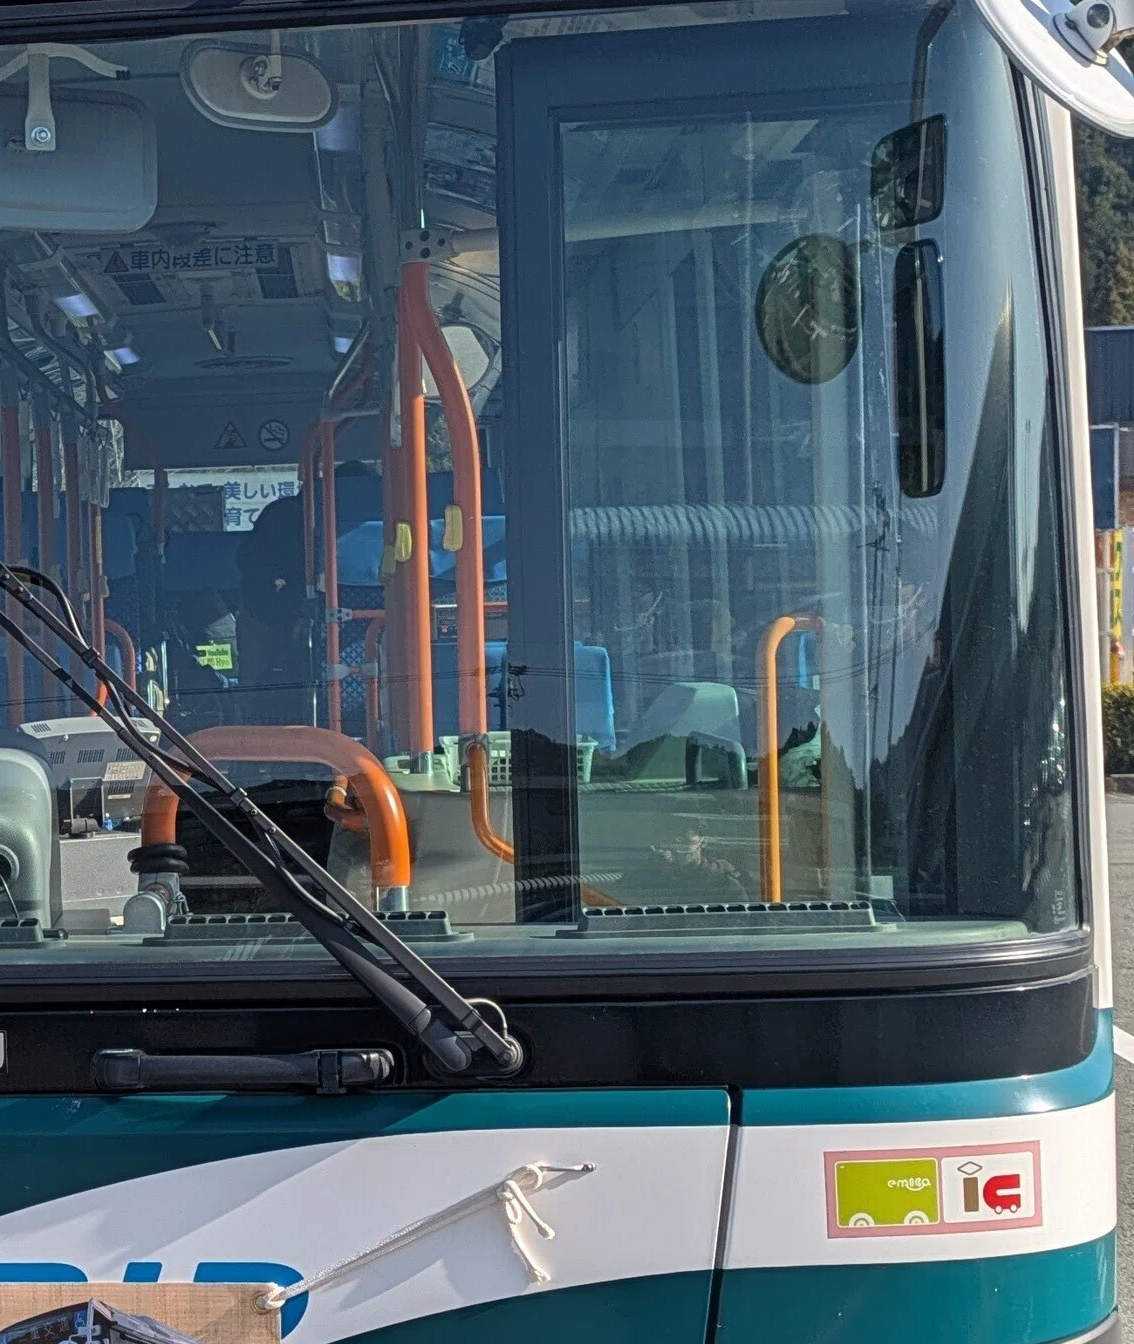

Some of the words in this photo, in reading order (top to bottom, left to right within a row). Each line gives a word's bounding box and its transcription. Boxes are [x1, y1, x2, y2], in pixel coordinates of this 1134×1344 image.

[130, 244, 276, 271] 車内段差に注意
[224, 481, 302, 500] 美しい環
